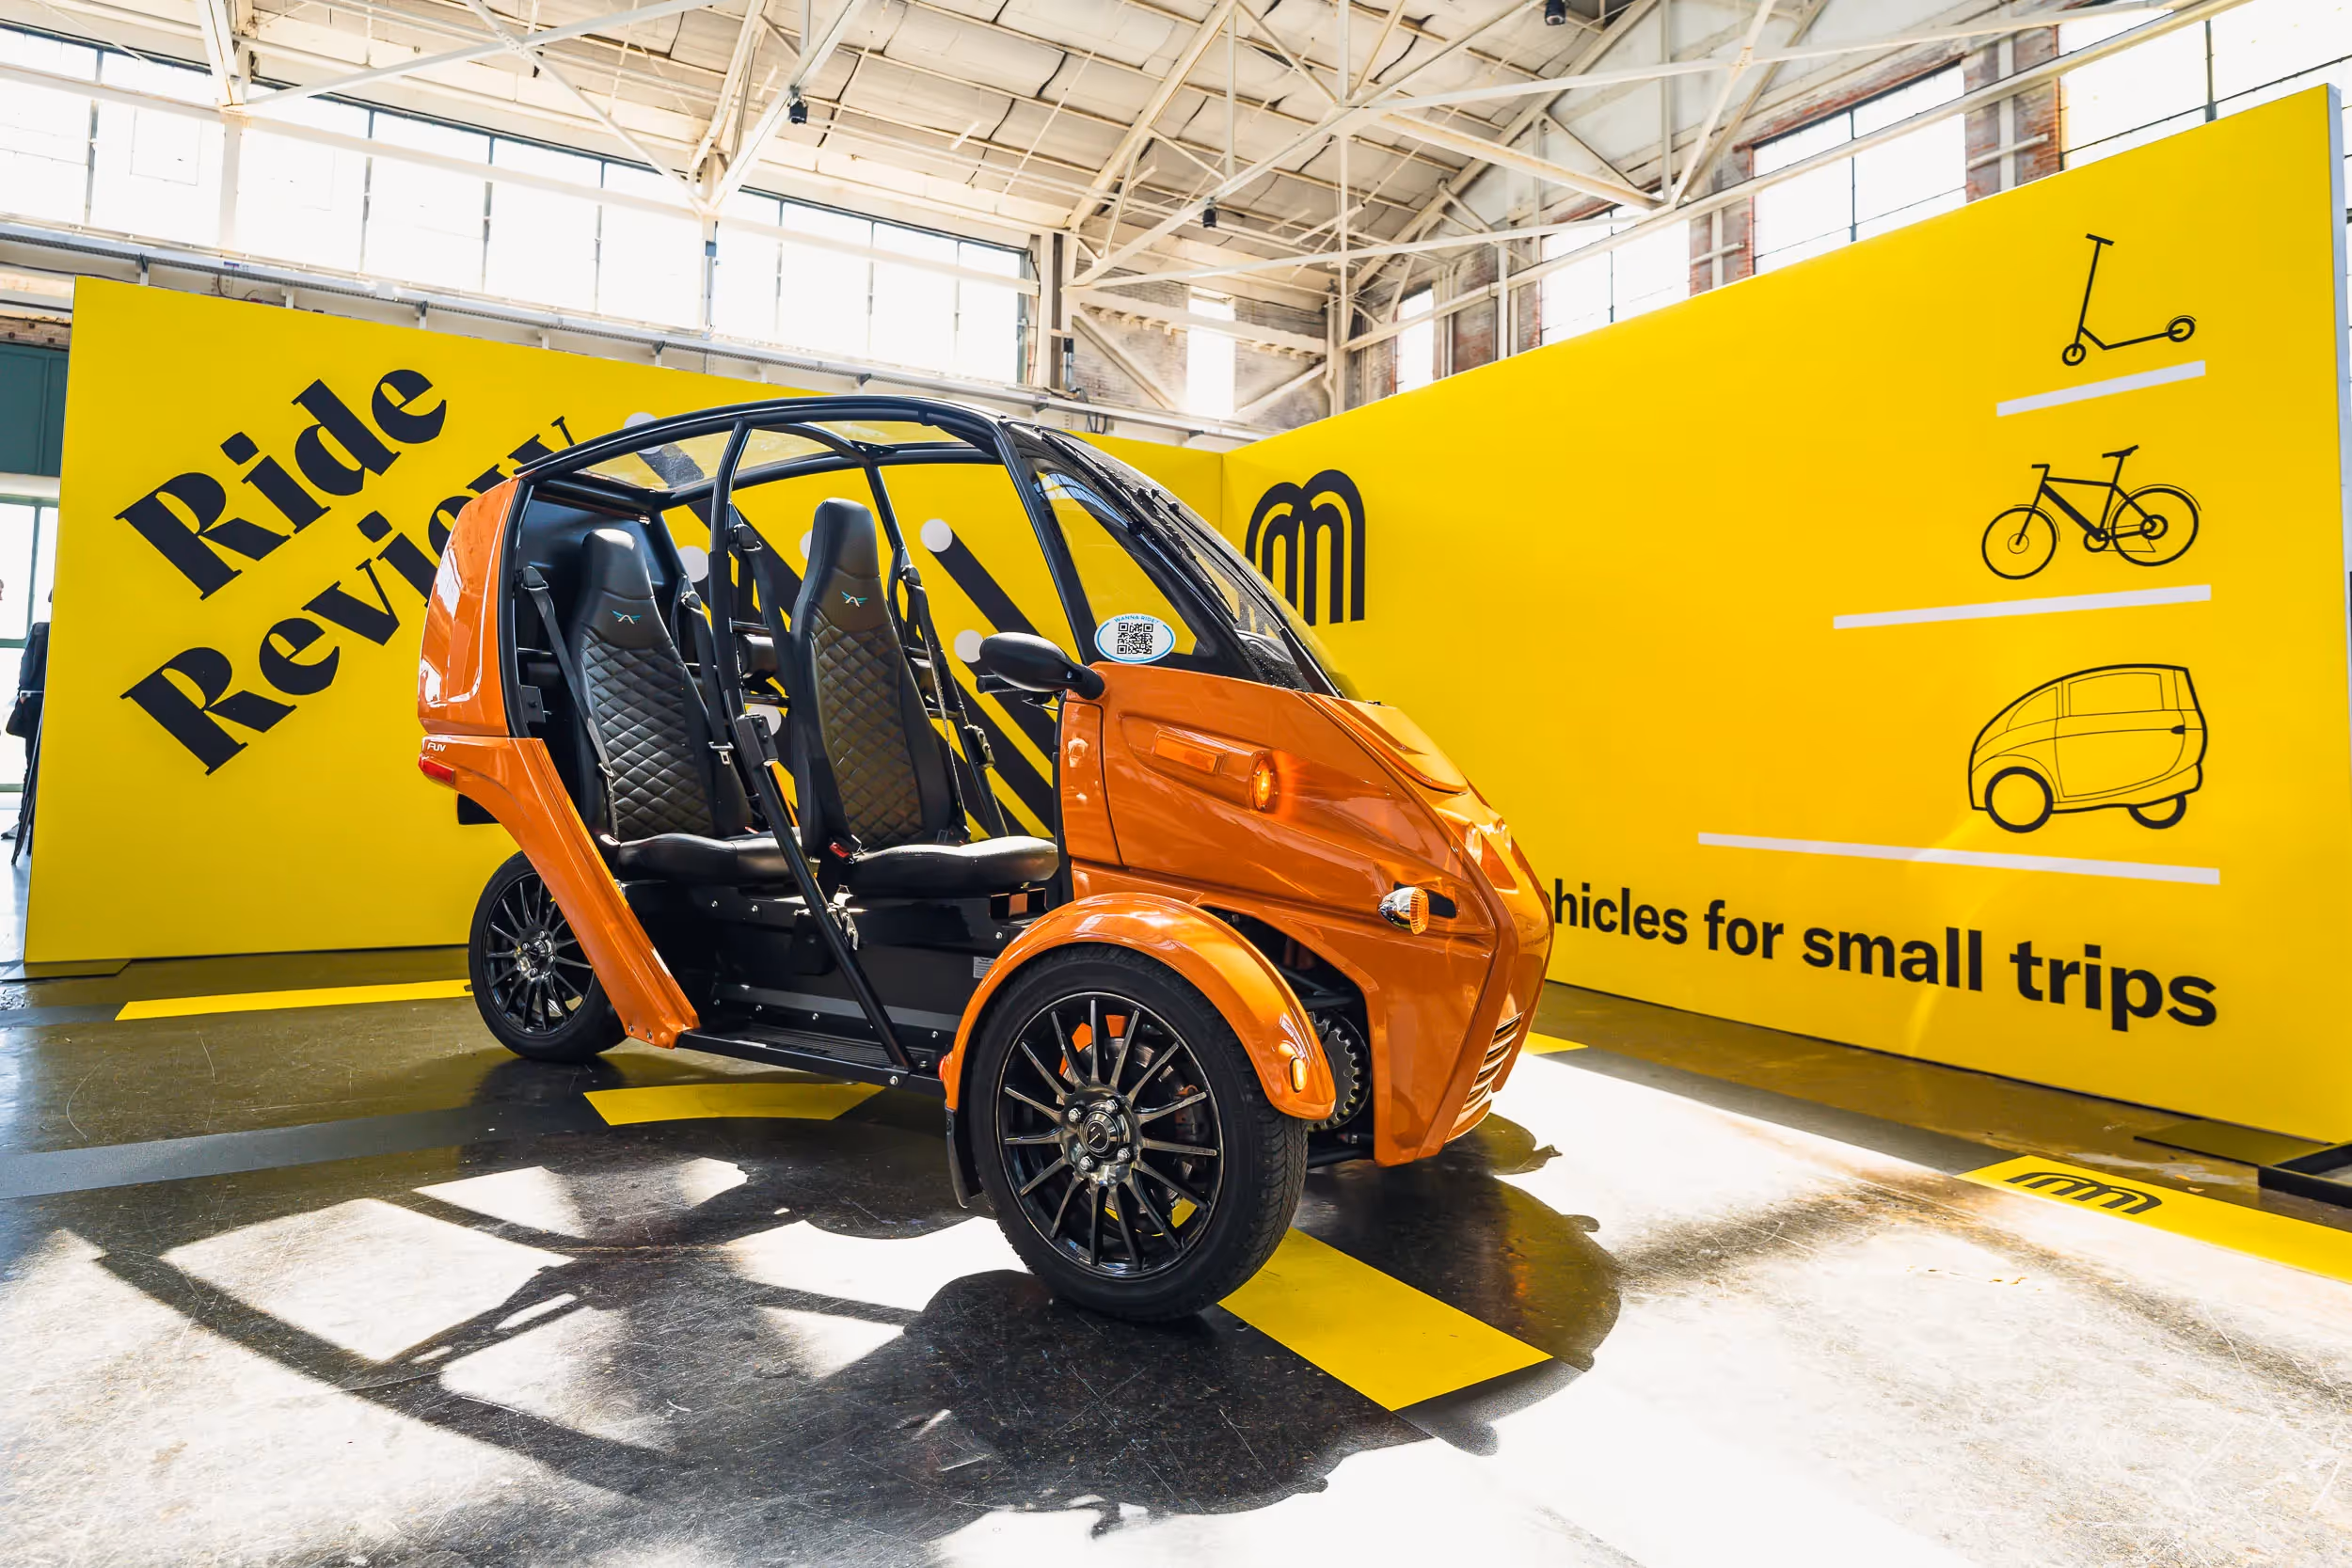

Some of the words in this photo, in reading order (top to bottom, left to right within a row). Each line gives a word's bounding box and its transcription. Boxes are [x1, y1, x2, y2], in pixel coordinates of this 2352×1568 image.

[114, 369, 447, 600] Ride
[119, 416, 576, 776] Revi
[427, 741, 447, 752] FUV
[1544, 878, 1689, 945] hicles
[1704, 899, 1785, 959] for
[1803, 927, 1982, 991] small
[2010, 941, 2217, 1033] trips
